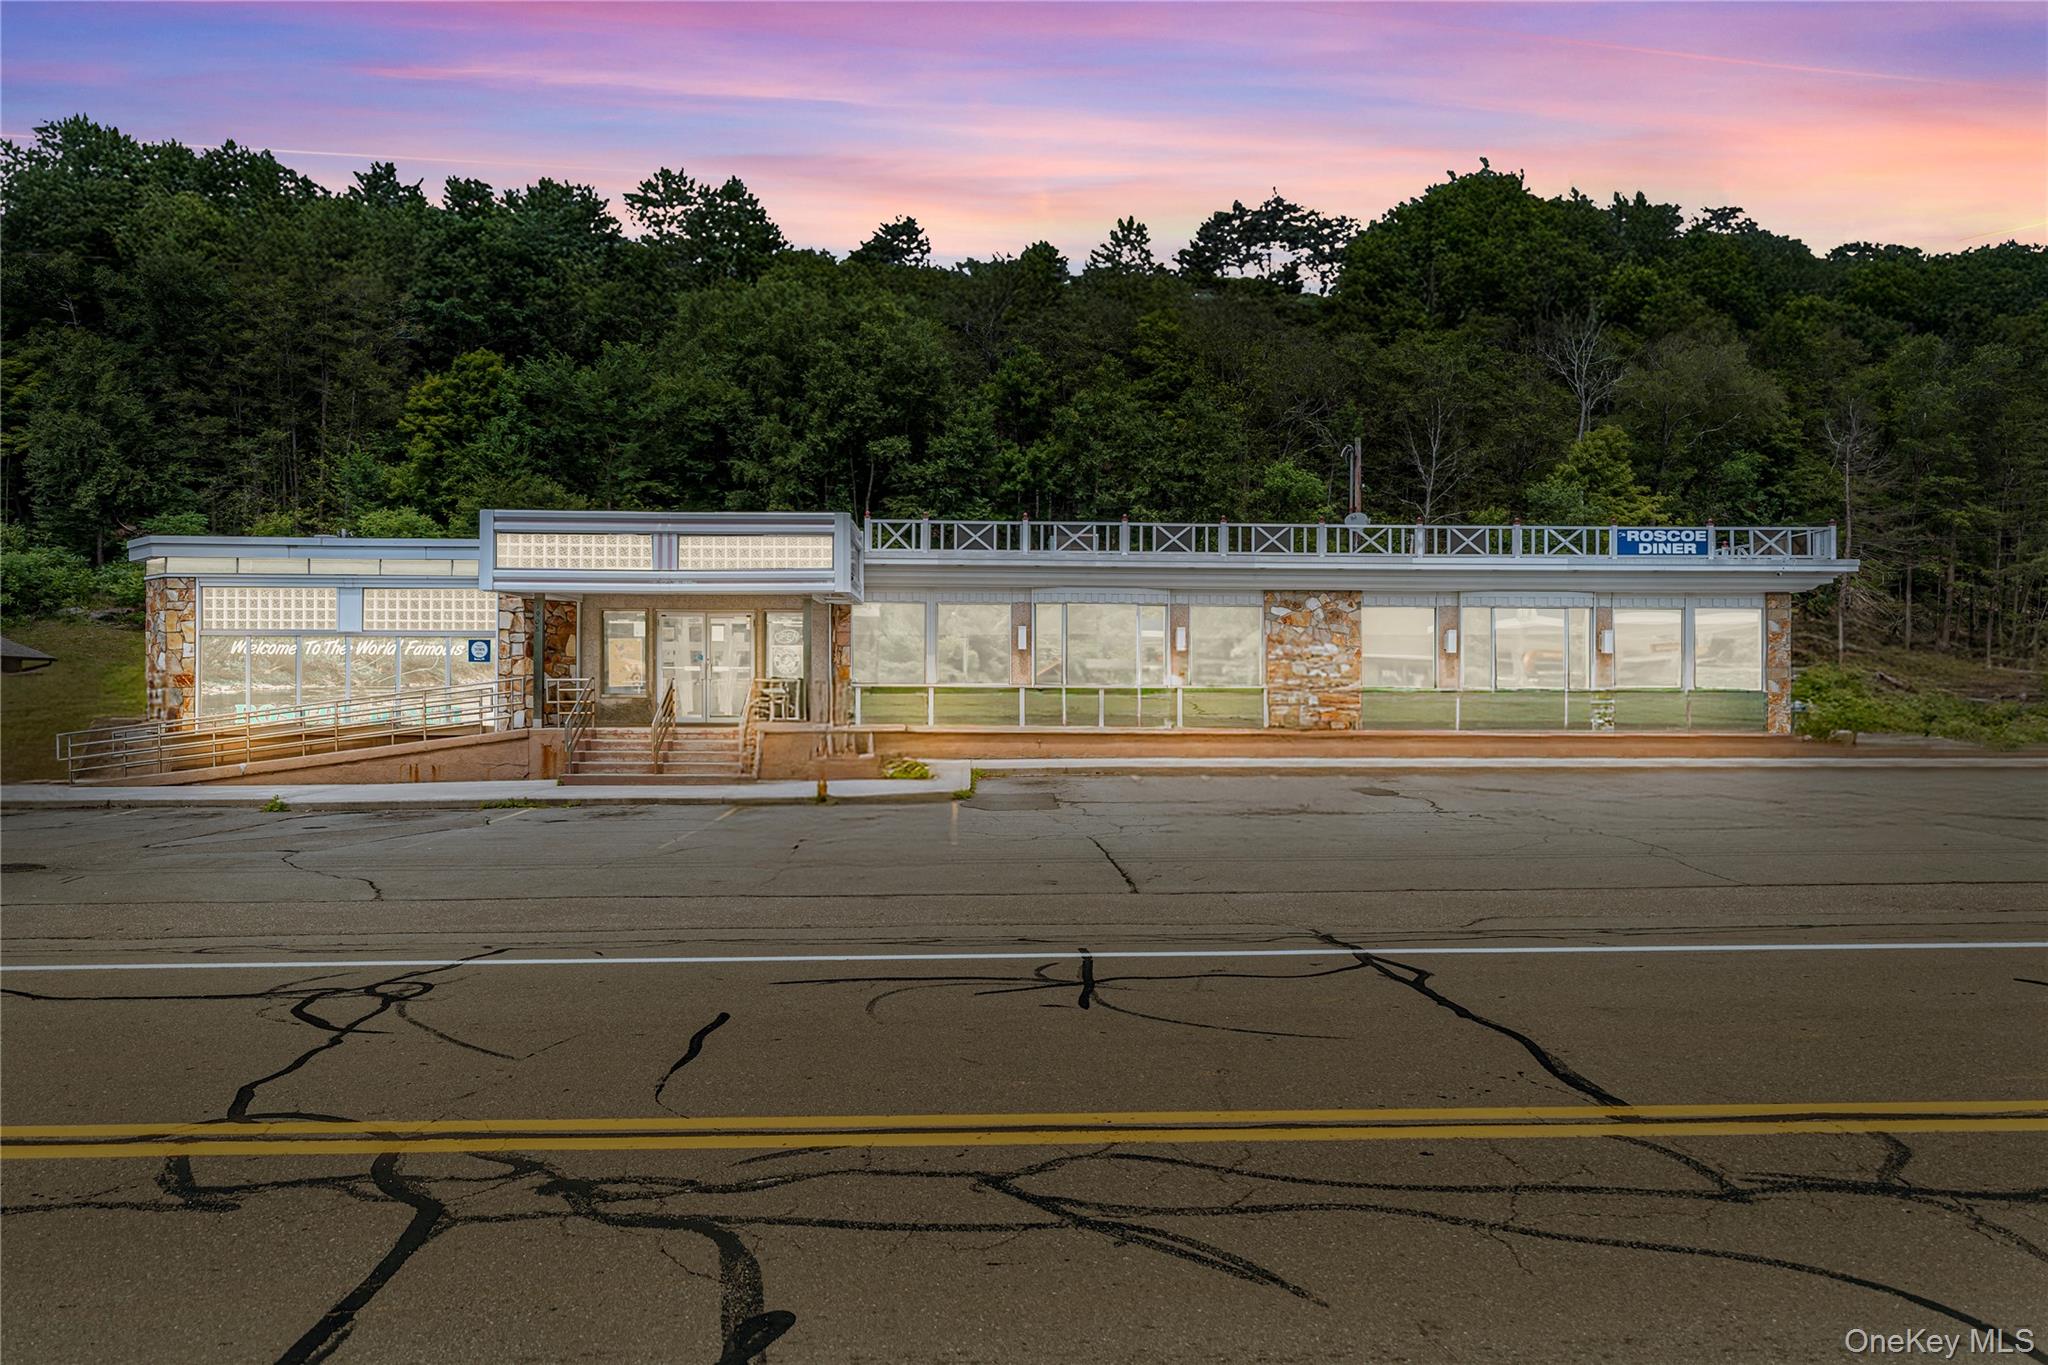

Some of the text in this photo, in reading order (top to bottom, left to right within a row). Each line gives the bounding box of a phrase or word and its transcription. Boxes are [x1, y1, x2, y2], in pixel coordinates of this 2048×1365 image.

[1626, 530, 1707, 542] ROSCOE
[1638, 542, 1697, 555] DINER
[230, 638, 466, 656] Welcome To The World Famous
